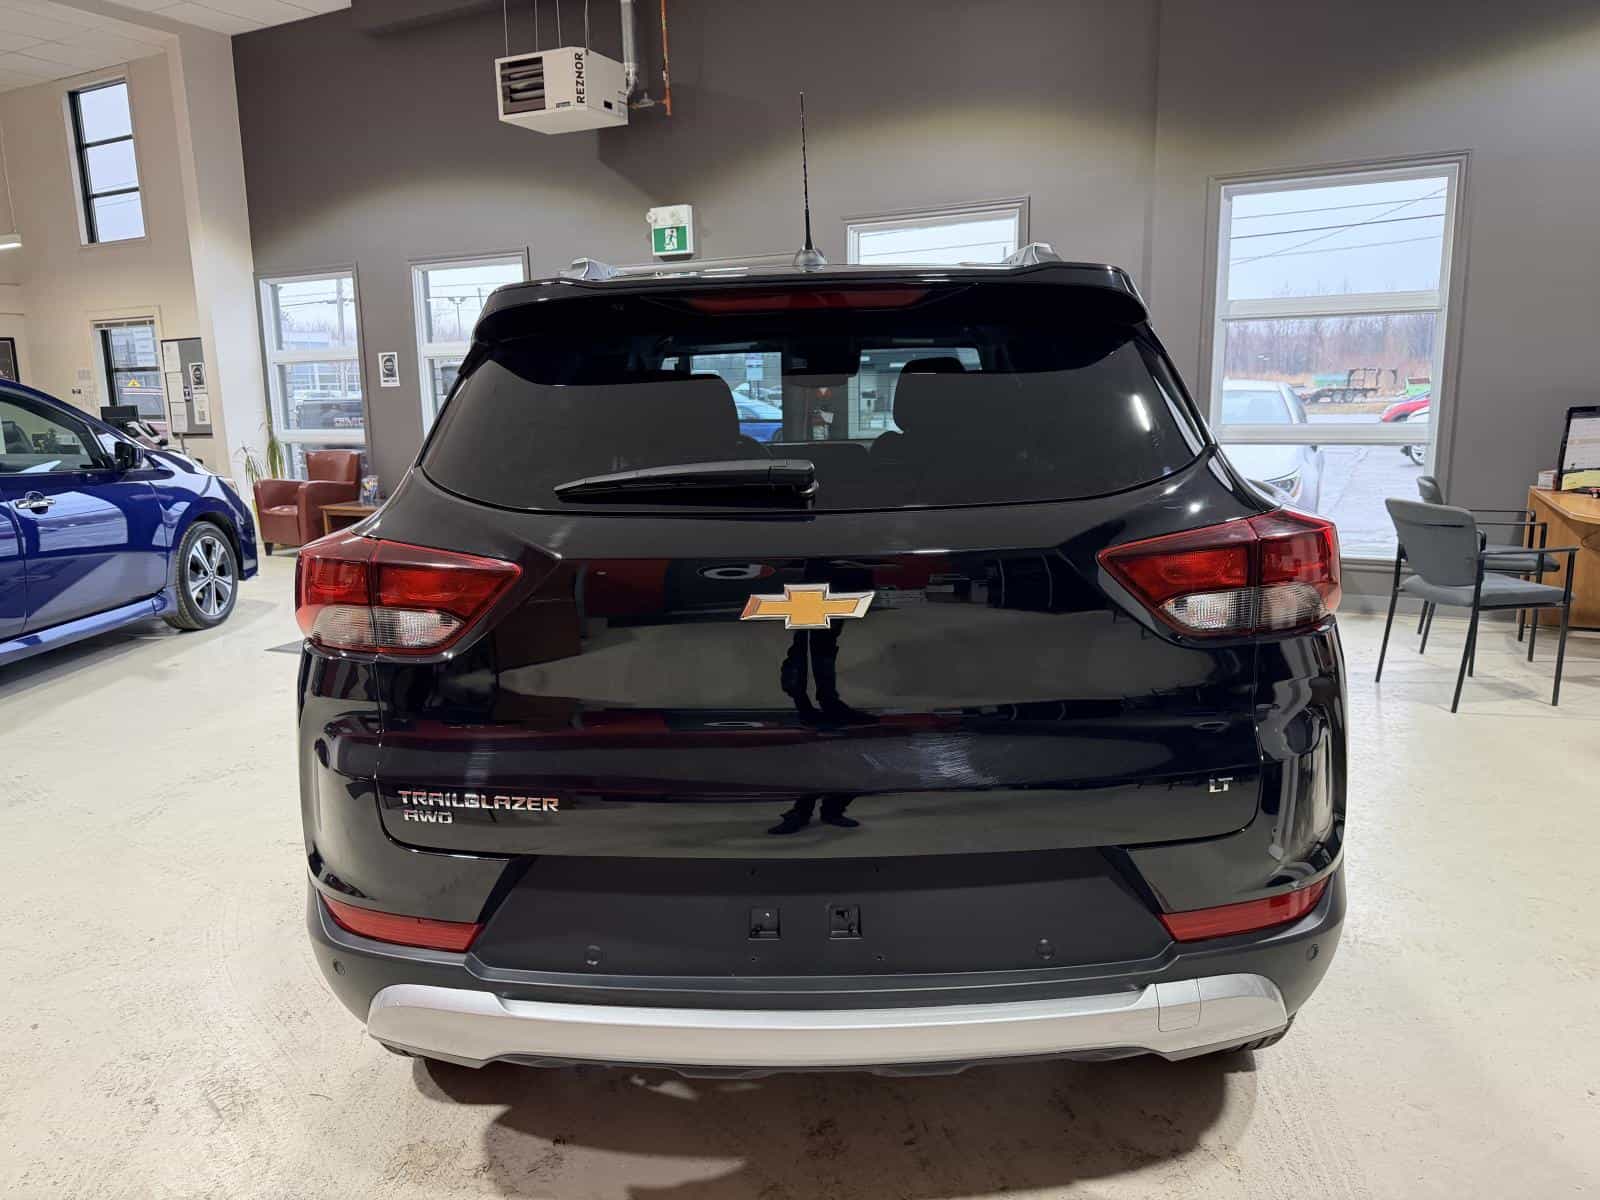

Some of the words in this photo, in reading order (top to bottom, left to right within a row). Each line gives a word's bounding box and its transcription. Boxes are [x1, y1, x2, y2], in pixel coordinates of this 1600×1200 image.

[574, 52, 585, 104] REZNOR
[1209, 777, 1233, 792] LT
[398, 790, 559, 812] TRAILBLAZER
[403, 809, 453, 824] AWD
